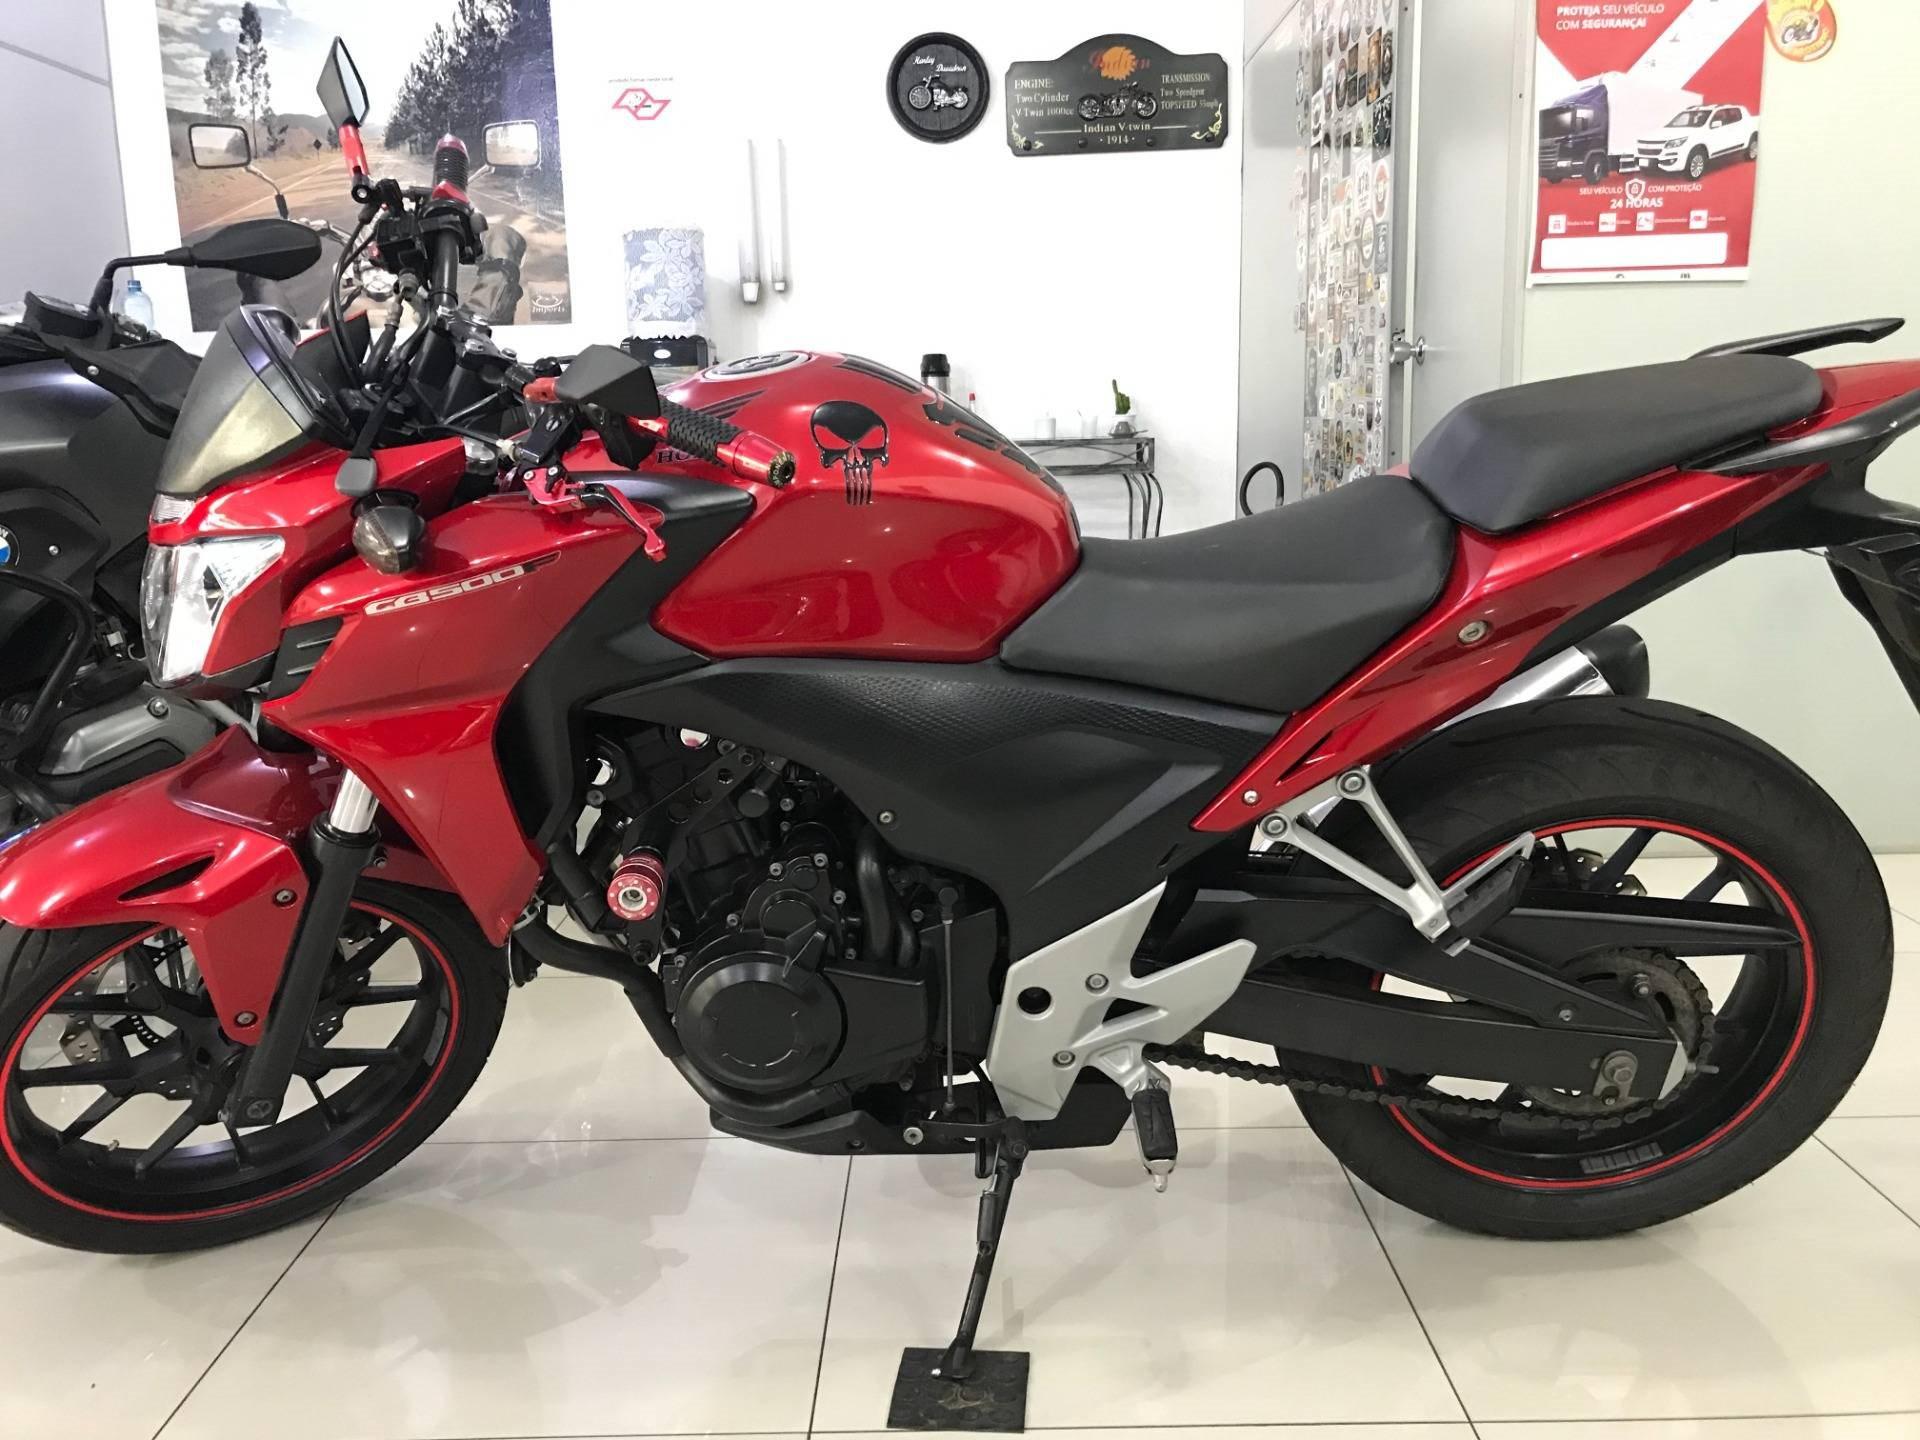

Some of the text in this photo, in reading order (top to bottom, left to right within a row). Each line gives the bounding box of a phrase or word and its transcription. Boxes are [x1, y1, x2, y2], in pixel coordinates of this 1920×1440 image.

[1556, 2, 1664, 17] PROTEJA SEU VEÍCULO
[1555, 19, 1580, 30] COM
[1015, 91, 1070, 105] Two Cylinder
[1084, 122, 1116, 133] Indian
[1107, 135, 1129, 145] 1914
[1579, 187, 1593, 195] SEU
[1594, 185, 1623, 195] VEÍCULO
[1648, 184, 1664, 193] COM
[1610, 197, 1664, 209] 24 HORAS
[364, 564, 525, 616] CB500
